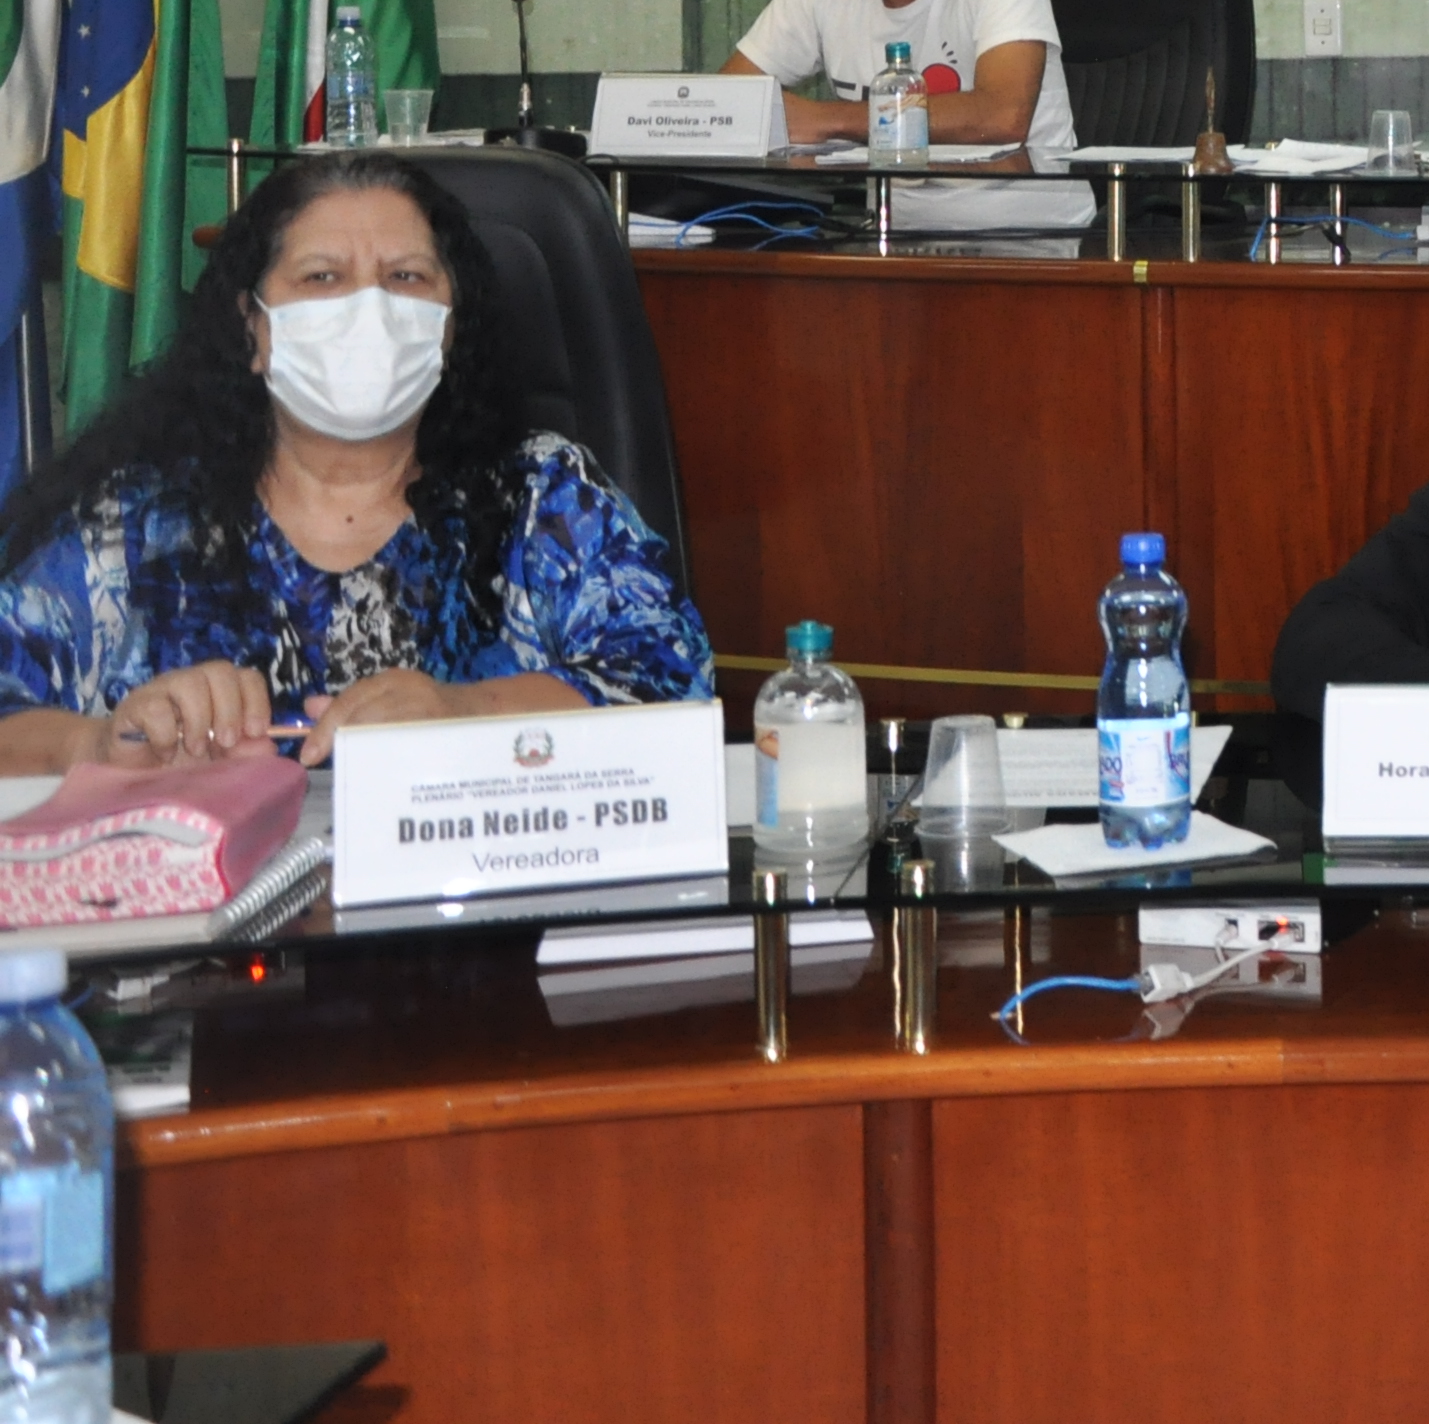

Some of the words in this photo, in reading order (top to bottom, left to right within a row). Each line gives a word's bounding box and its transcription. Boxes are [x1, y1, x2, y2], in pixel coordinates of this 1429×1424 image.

[627, 116, 652, 125] Davi
[655, 116, 699, 126] Oliveira
[709, 117, 733, 126] PSB
[647, 130, 712, 139] Vice-Presidente
[458, 776, 512, 790] MUNICIPAL
[516, 776, 530, 784] DE
[585, 770, 598, 780] DA
[399, 815, 475, 844] Dona
[483, 805, 569, 837] Neide
[594, 797, 669, 828] PSDB
[471, 845, 600, 874] Vereadora
